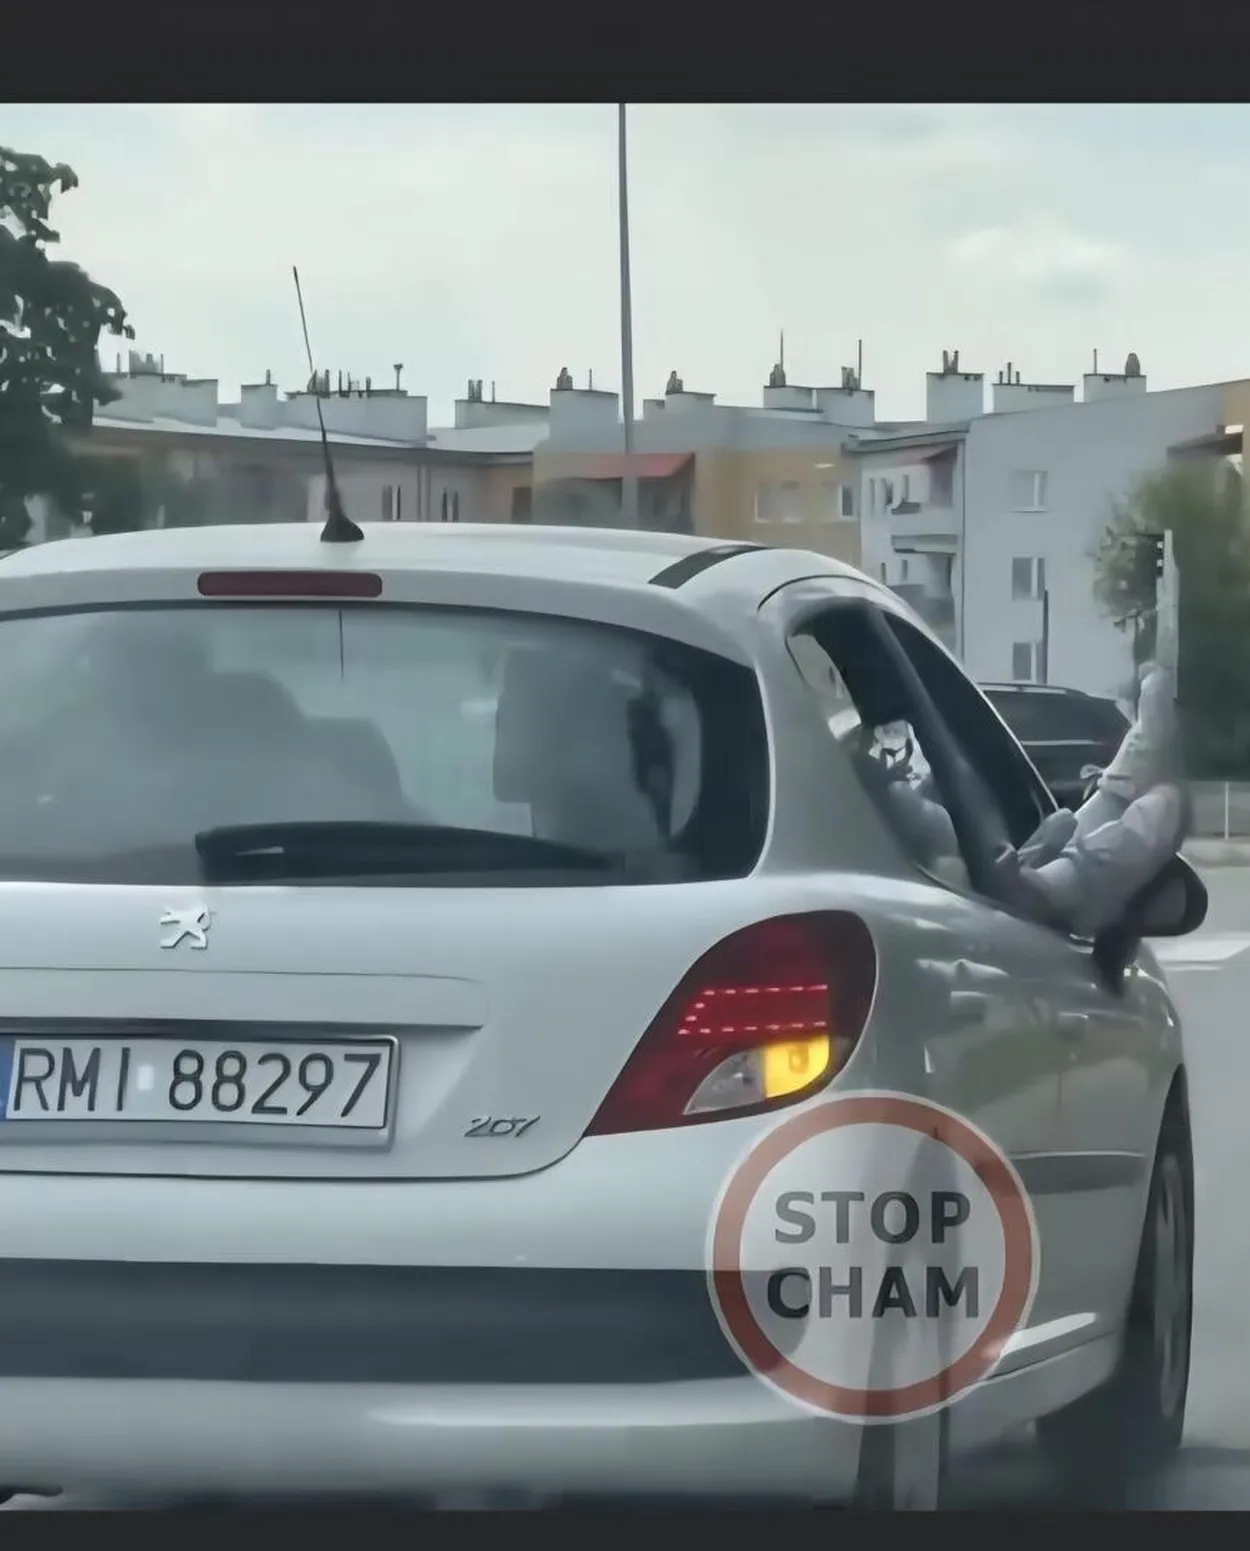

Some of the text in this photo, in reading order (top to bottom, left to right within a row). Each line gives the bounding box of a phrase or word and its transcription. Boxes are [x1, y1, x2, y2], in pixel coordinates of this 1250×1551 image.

[13, 1046, 382, 1117] RMI 88297
[464, 1115, 541, 1138] 207
